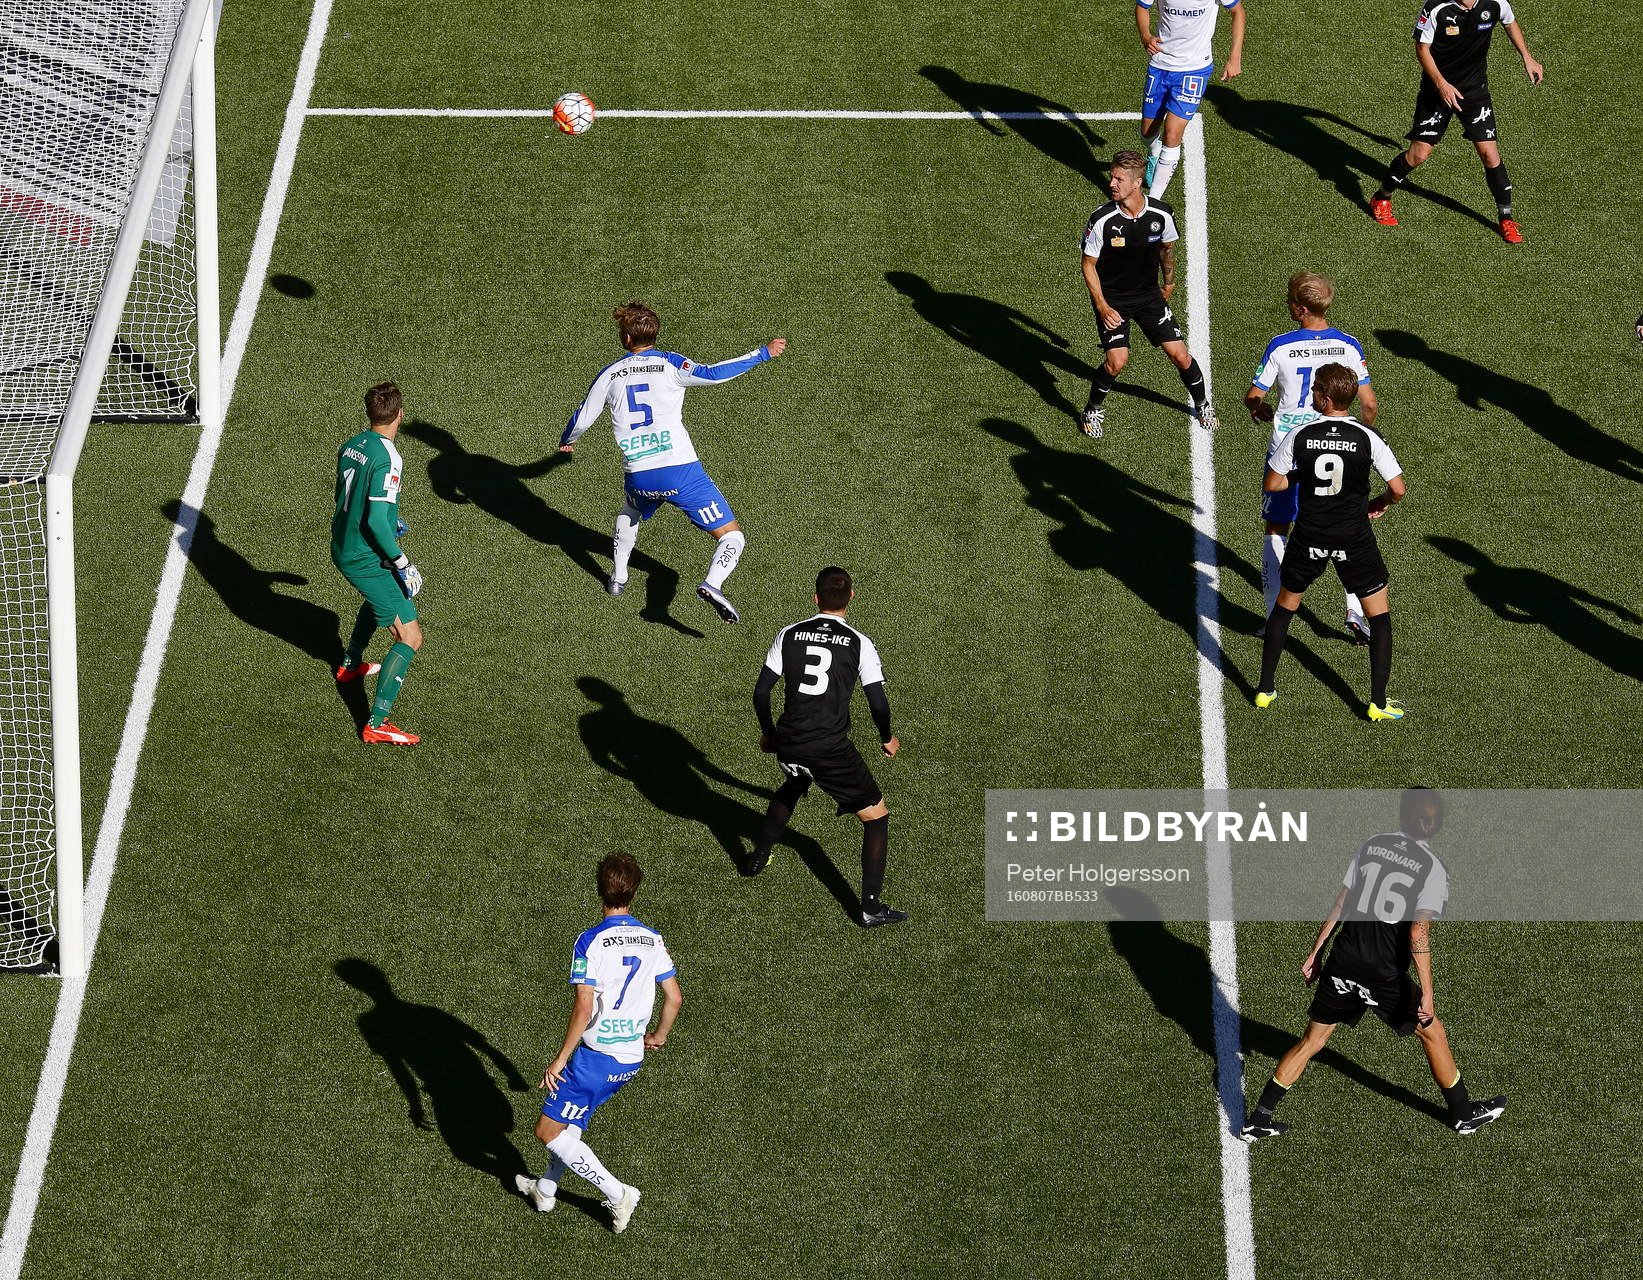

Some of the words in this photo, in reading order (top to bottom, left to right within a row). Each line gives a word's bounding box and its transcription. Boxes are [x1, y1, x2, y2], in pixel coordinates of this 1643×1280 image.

[1164, 7, 1206, 17] HOLMEN
[1289, 349, 1310, 358] axs
[610, 367, 629, 381] axs
[1296, 367, 1314, 409] 1
[626, 383, 654, 431] 5
[1280, 413, 1317, 425] SEF
[619, 430, 672, 452] SEFAB
[1306, 439, 1358, 452] BROBERG
[1314, 453, 1345, 497] 9
[343, 467, 356, 513] 1
[698, 500, 724, 525] nt
[794, 631, 851, 647] HINES-IKE
[798, 645, 833, 696] 3
[1366, 845, 1424, 874] NORDMARK
[1356, 861, 1416, 925] 16
[603, 936, 624, 947] axs
[612, 955, 642, 1010] 7
[560, 1100, 590, 1120] nt
